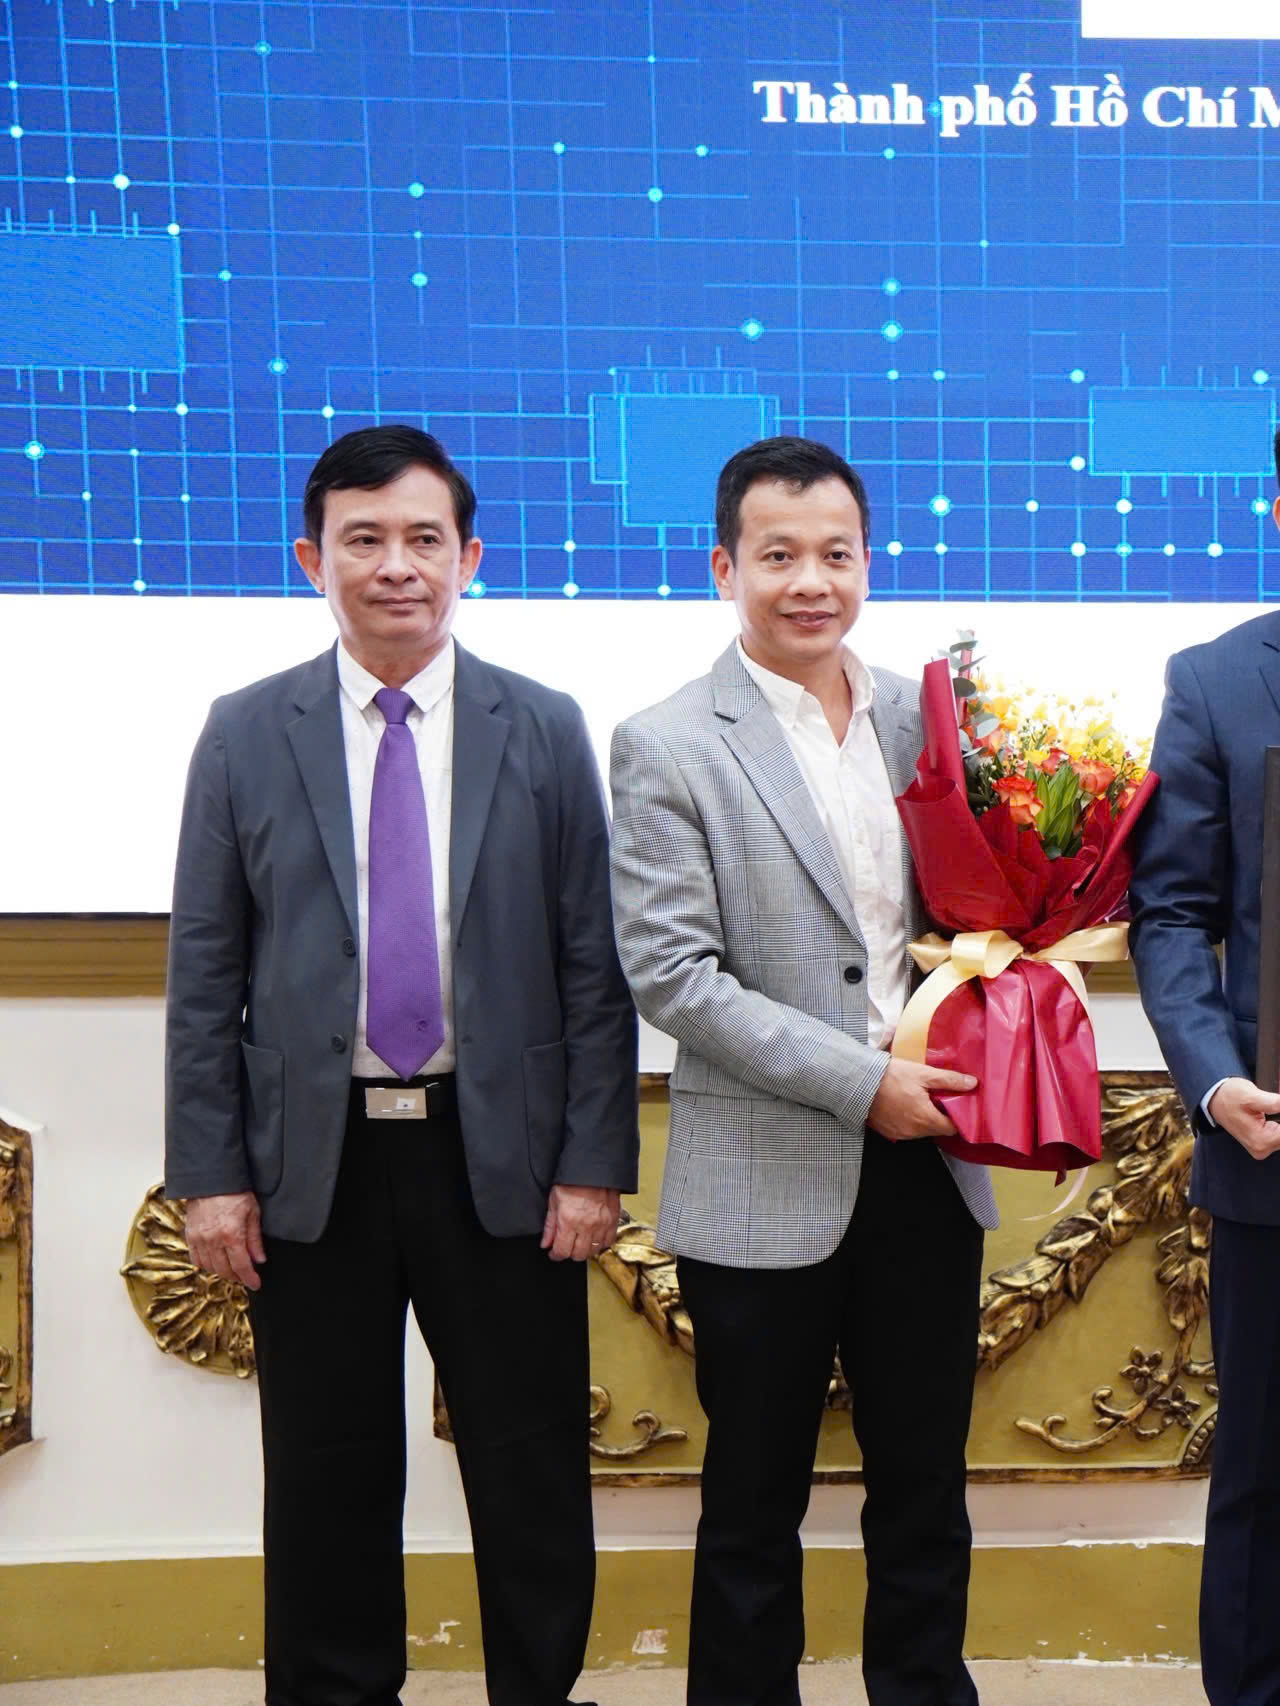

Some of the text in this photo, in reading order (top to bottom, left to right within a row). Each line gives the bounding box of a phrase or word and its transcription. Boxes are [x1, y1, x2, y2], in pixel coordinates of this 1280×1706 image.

[753, 80, 926, 125] Thành
[939, 72, 1038, 138] phố
[1050, 73, 1129, 128] Hồ
[1142, 86, 1238, 128] Chí
